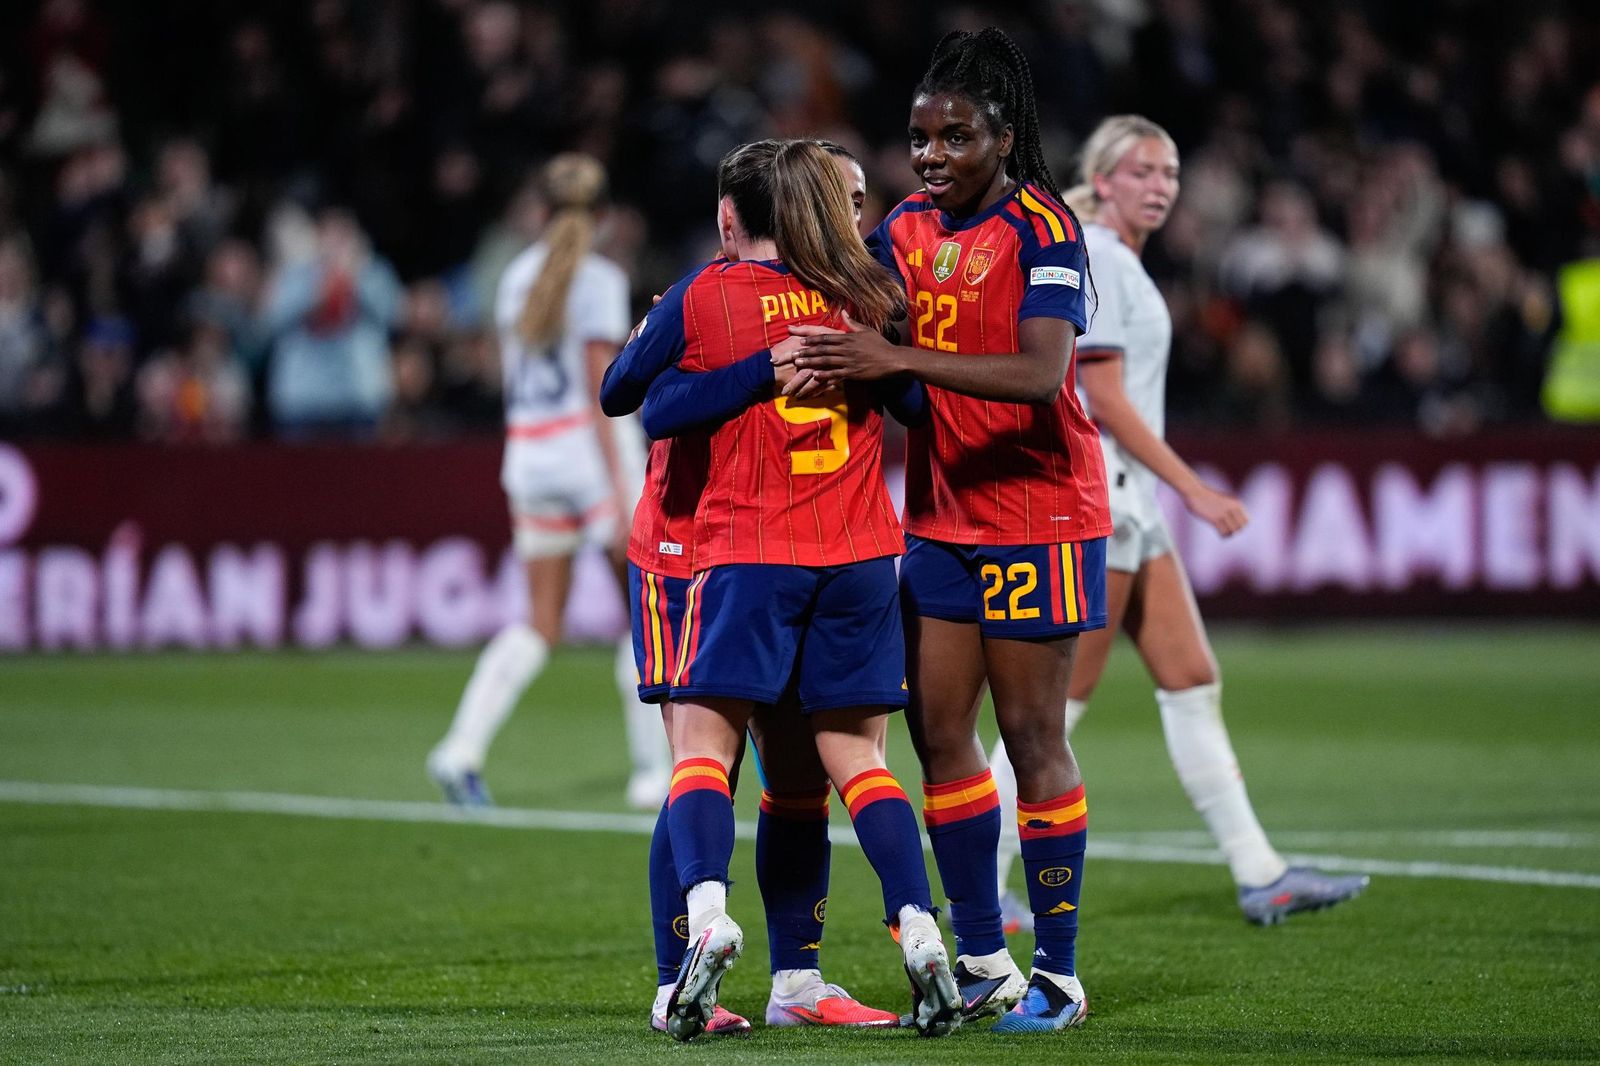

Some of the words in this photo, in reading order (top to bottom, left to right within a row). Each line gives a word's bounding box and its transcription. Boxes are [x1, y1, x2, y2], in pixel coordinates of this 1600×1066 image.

[1032, 271, 1079, 283] FOUNDATION
[760, 289, 828, 323] PINA
[916, 290, 958, 352] 22
[980, 561, 1041, 621] 22
